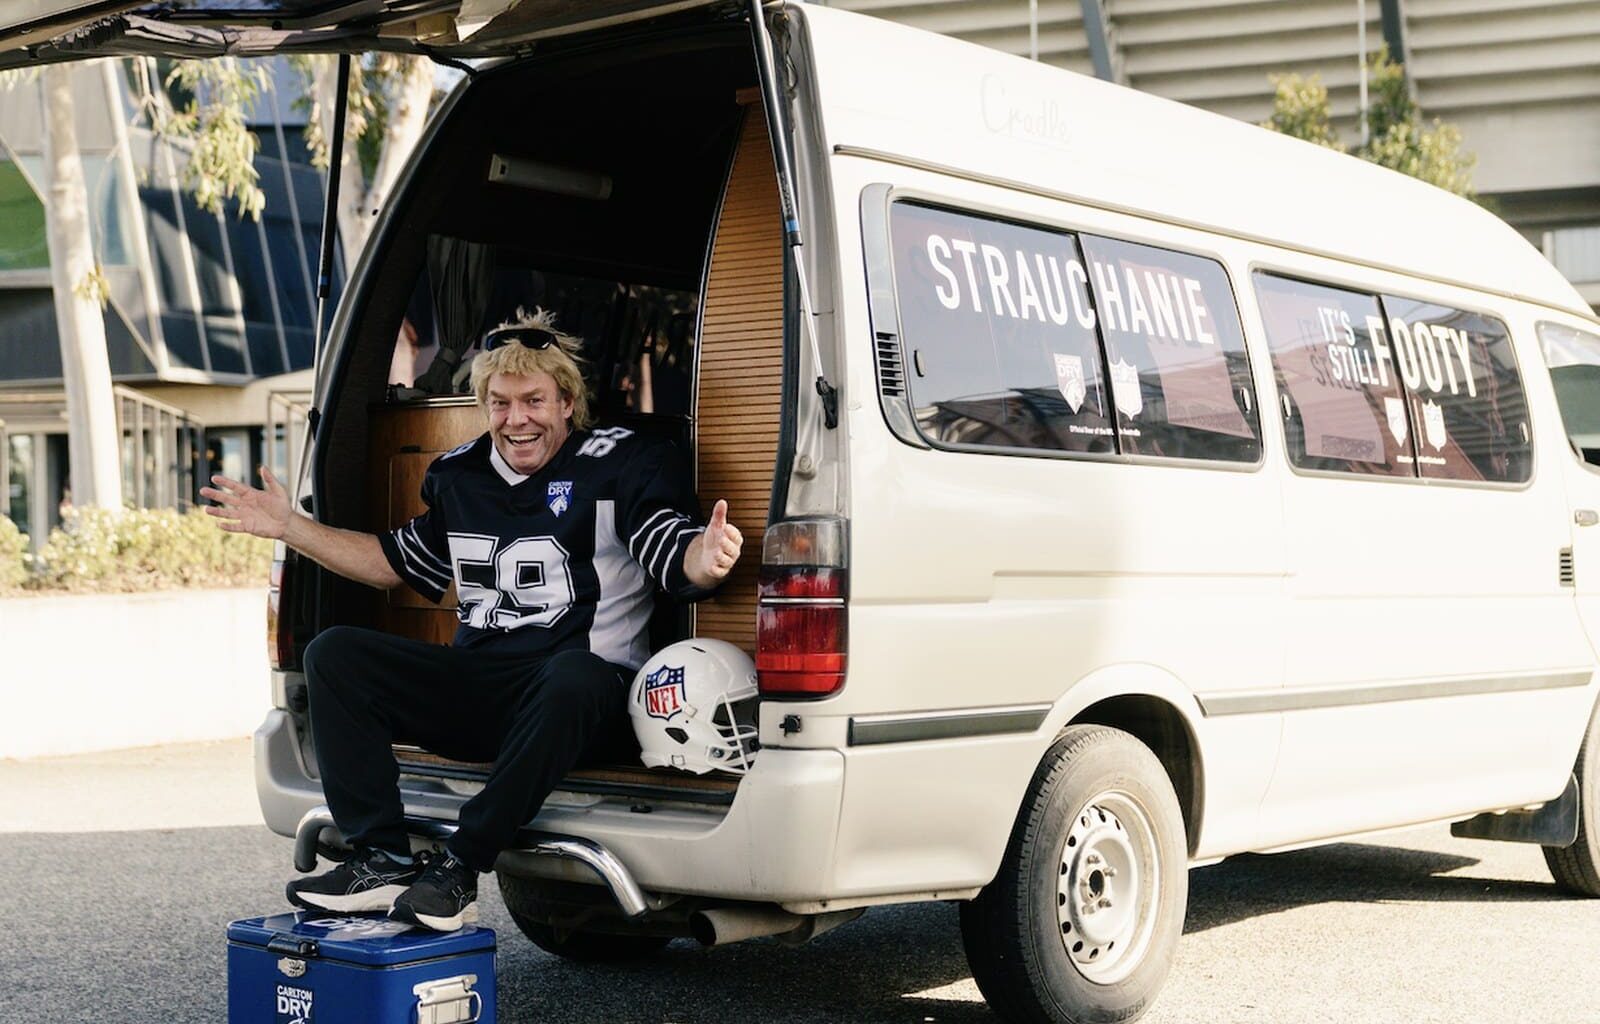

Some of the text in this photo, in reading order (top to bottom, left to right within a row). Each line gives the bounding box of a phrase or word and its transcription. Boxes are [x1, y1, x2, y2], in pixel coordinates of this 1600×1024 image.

[926, 234, 1215, 344] STRAUCHANIE
[1317, 306, 1356, 346] IT'S
[1057, 364, 1081, 378] DRY
[1328, 344, 1380, 385] STILL
[1365, 315, 1477, 397] FOOTY
[548, 486, 571, 496] DRY
[446, 531, 577, 632] 59
[277, 985, 313, 1001] CARLTON
[277, 995, 312, 1018] DRY
